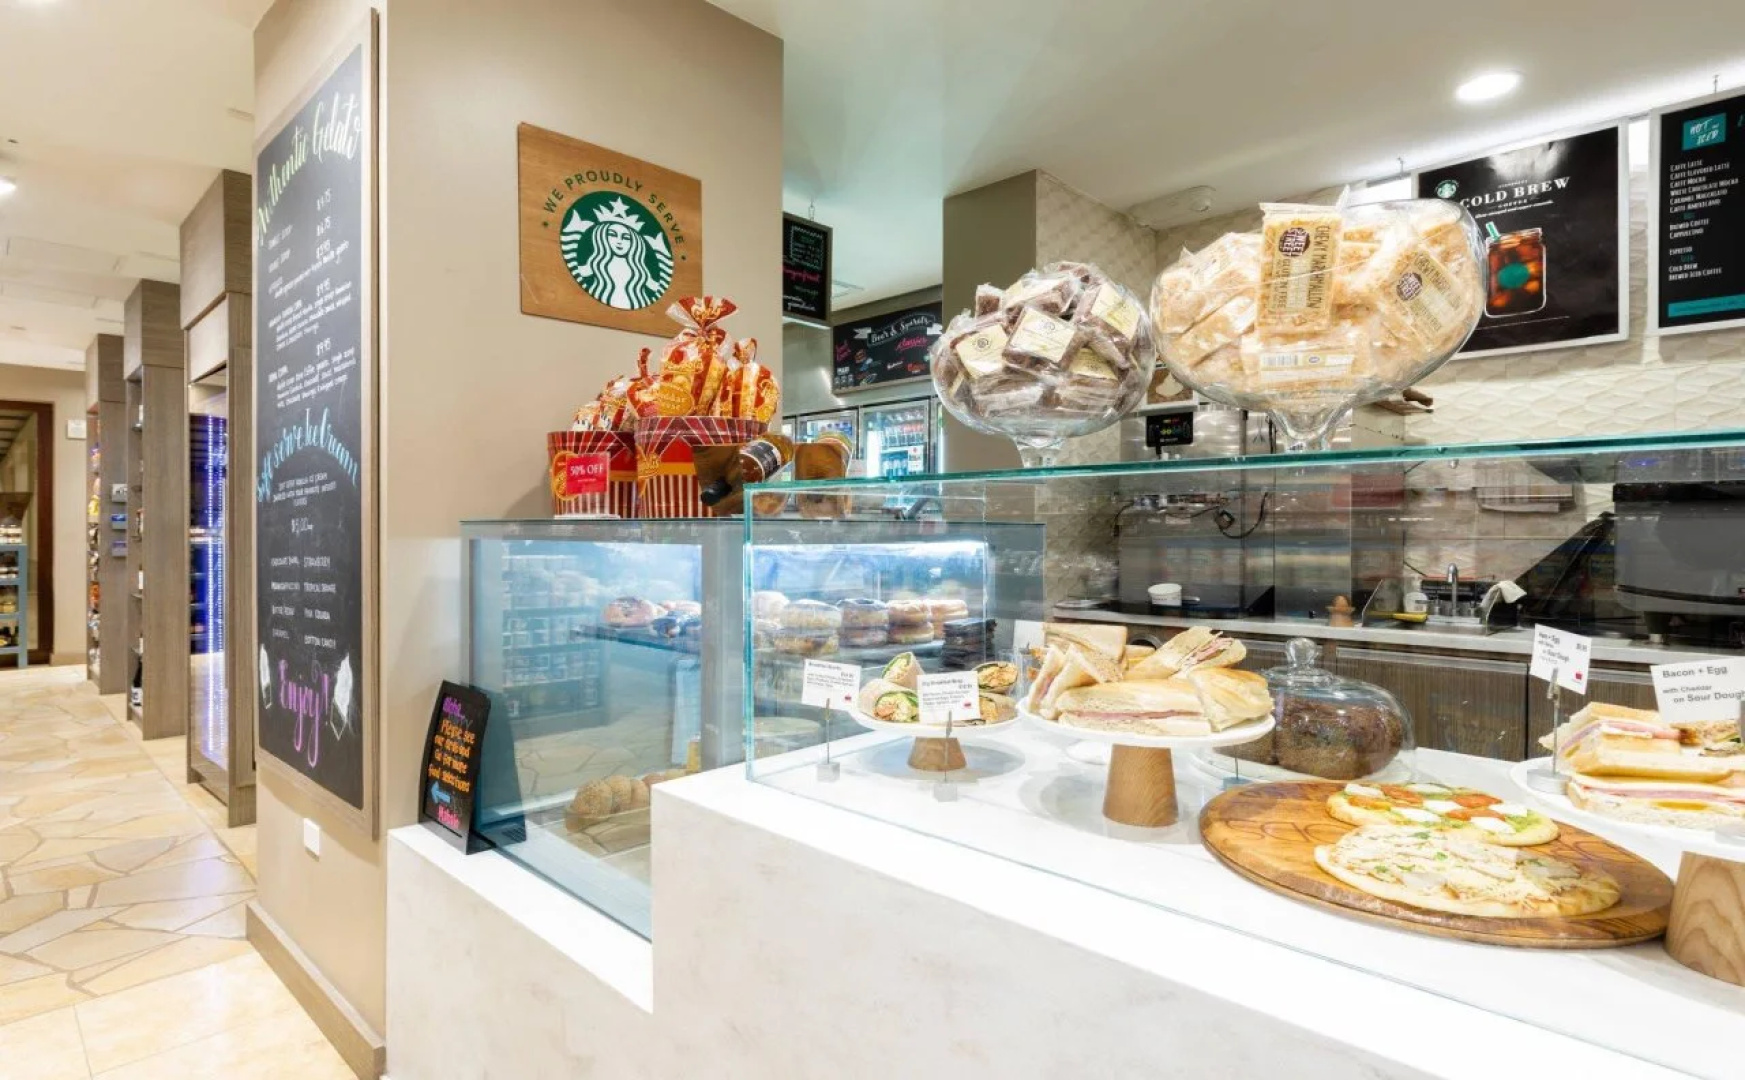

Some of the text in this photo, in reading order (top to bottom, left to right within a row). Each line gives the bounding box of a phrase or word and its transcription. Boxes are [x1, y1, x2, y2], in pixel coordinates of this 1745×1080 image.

[1460, 177, 1570, 208] COLD BREW
[544, 170, 685, 245] WE PROUDLY SERVE
[570, 463, 603, 476] 50% OFF
[1662, 669, 1695, 678] Bacon
[1706, 666, 1728, 676] Egg
[1680, 684, 1712, 694] Cheddar
[1687, 693, 1711, 703] Sour
